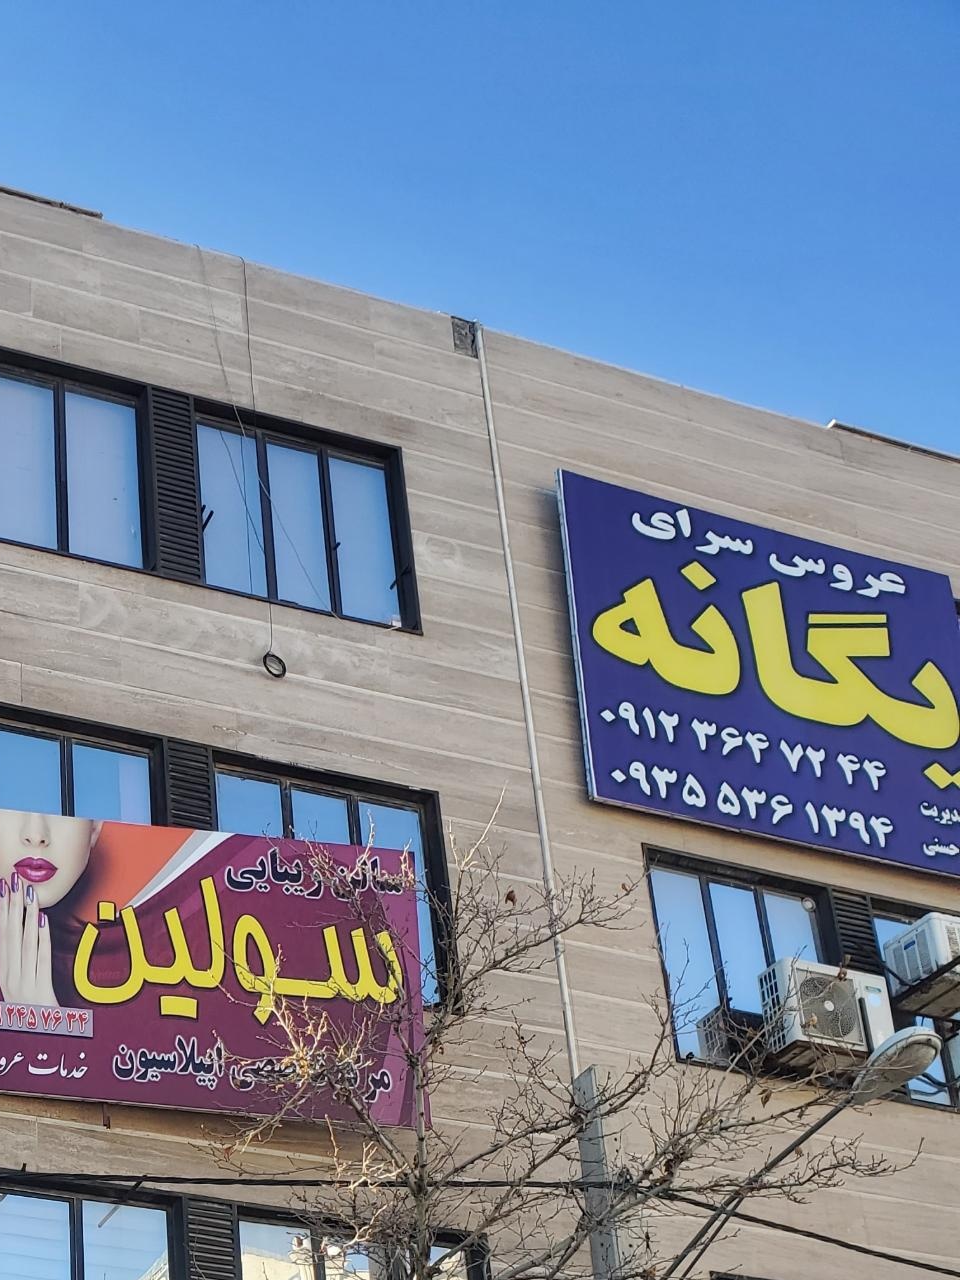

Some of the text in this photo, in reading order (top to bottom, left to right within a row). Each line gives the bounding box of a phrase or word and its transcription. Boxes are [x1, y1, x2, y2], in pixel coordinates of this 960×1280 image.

[631, 508, 906, 598] عروس سرای
[592, 560, 960, 789] یگانه
[600, 701, 887, 792] ۰۹۱۲ ۳۶۴ ۷۲ ۴۴
[610, 760, 894, 848] ۰۹۳۵ ۵۳۶ ۱۳۹۴
[72, 876, 405, 1026] سولین
[28, 1052, 88, 1079] خدمات
